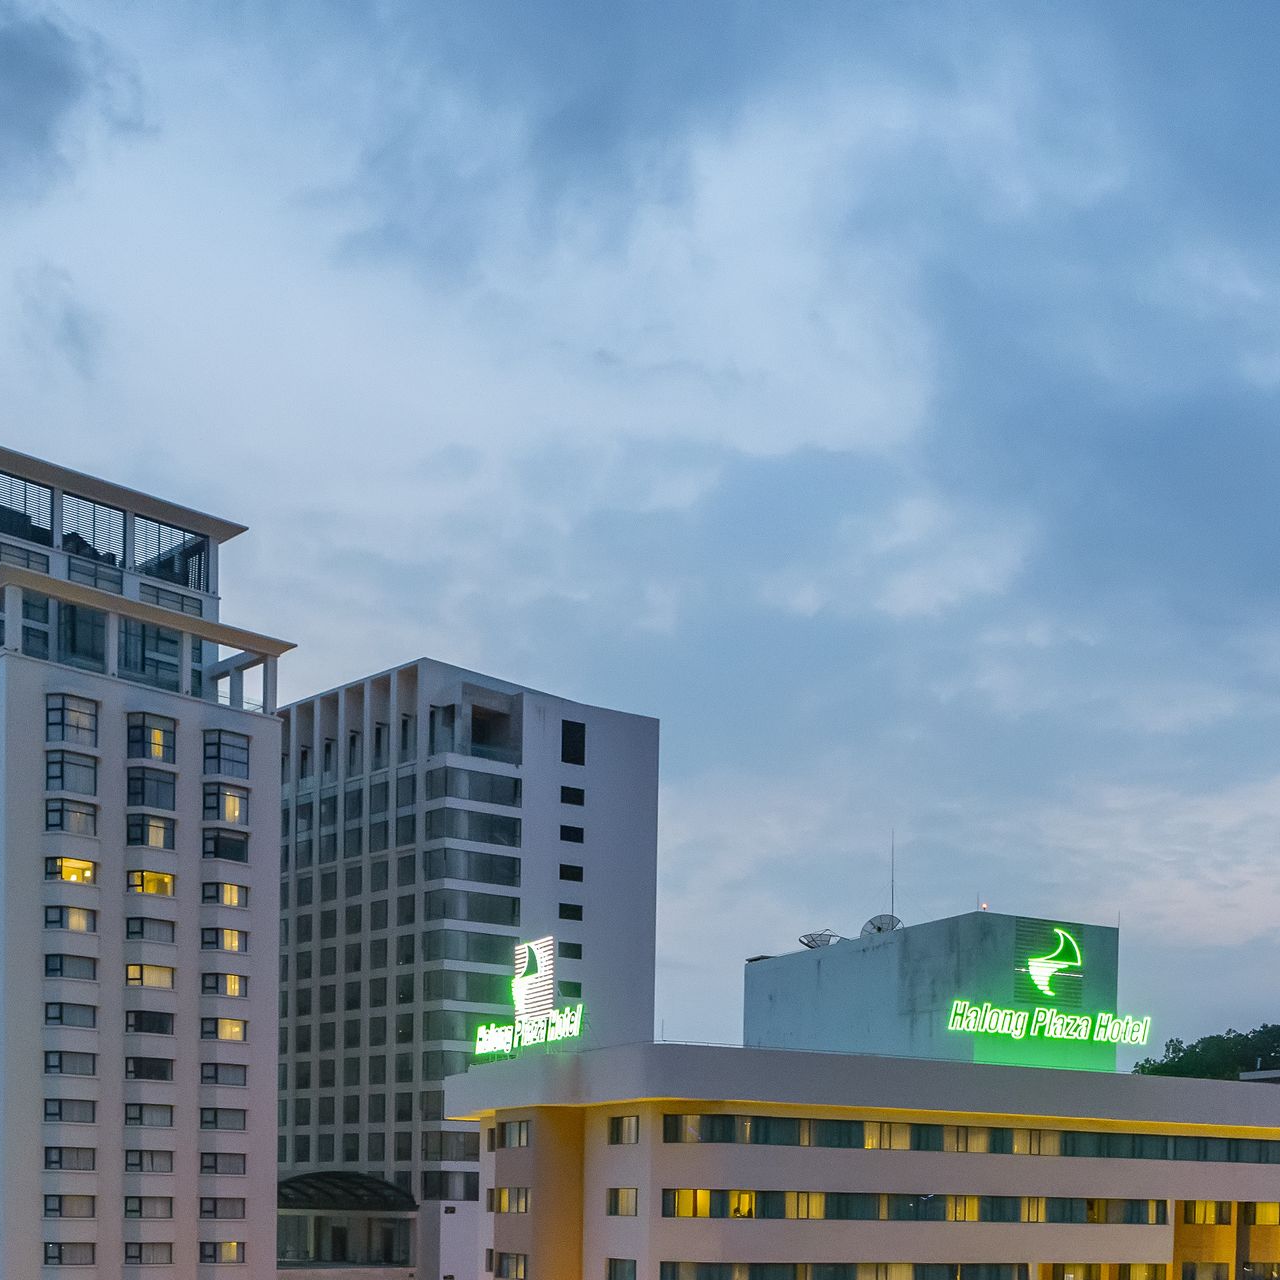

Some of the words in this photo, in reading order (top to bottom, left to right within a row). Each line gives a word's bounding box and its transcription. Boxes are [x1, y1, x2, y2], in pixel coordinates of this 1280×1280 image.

[514, 1015, 548, 1048] Plaza
[548, 1004, 583, 1041] Hotel
[949, 1000, 1029, 1040] Halong
[1030, 1007, 1091, 1040] Plaza
[1094, 1013, 1151, 1045] Hotel
